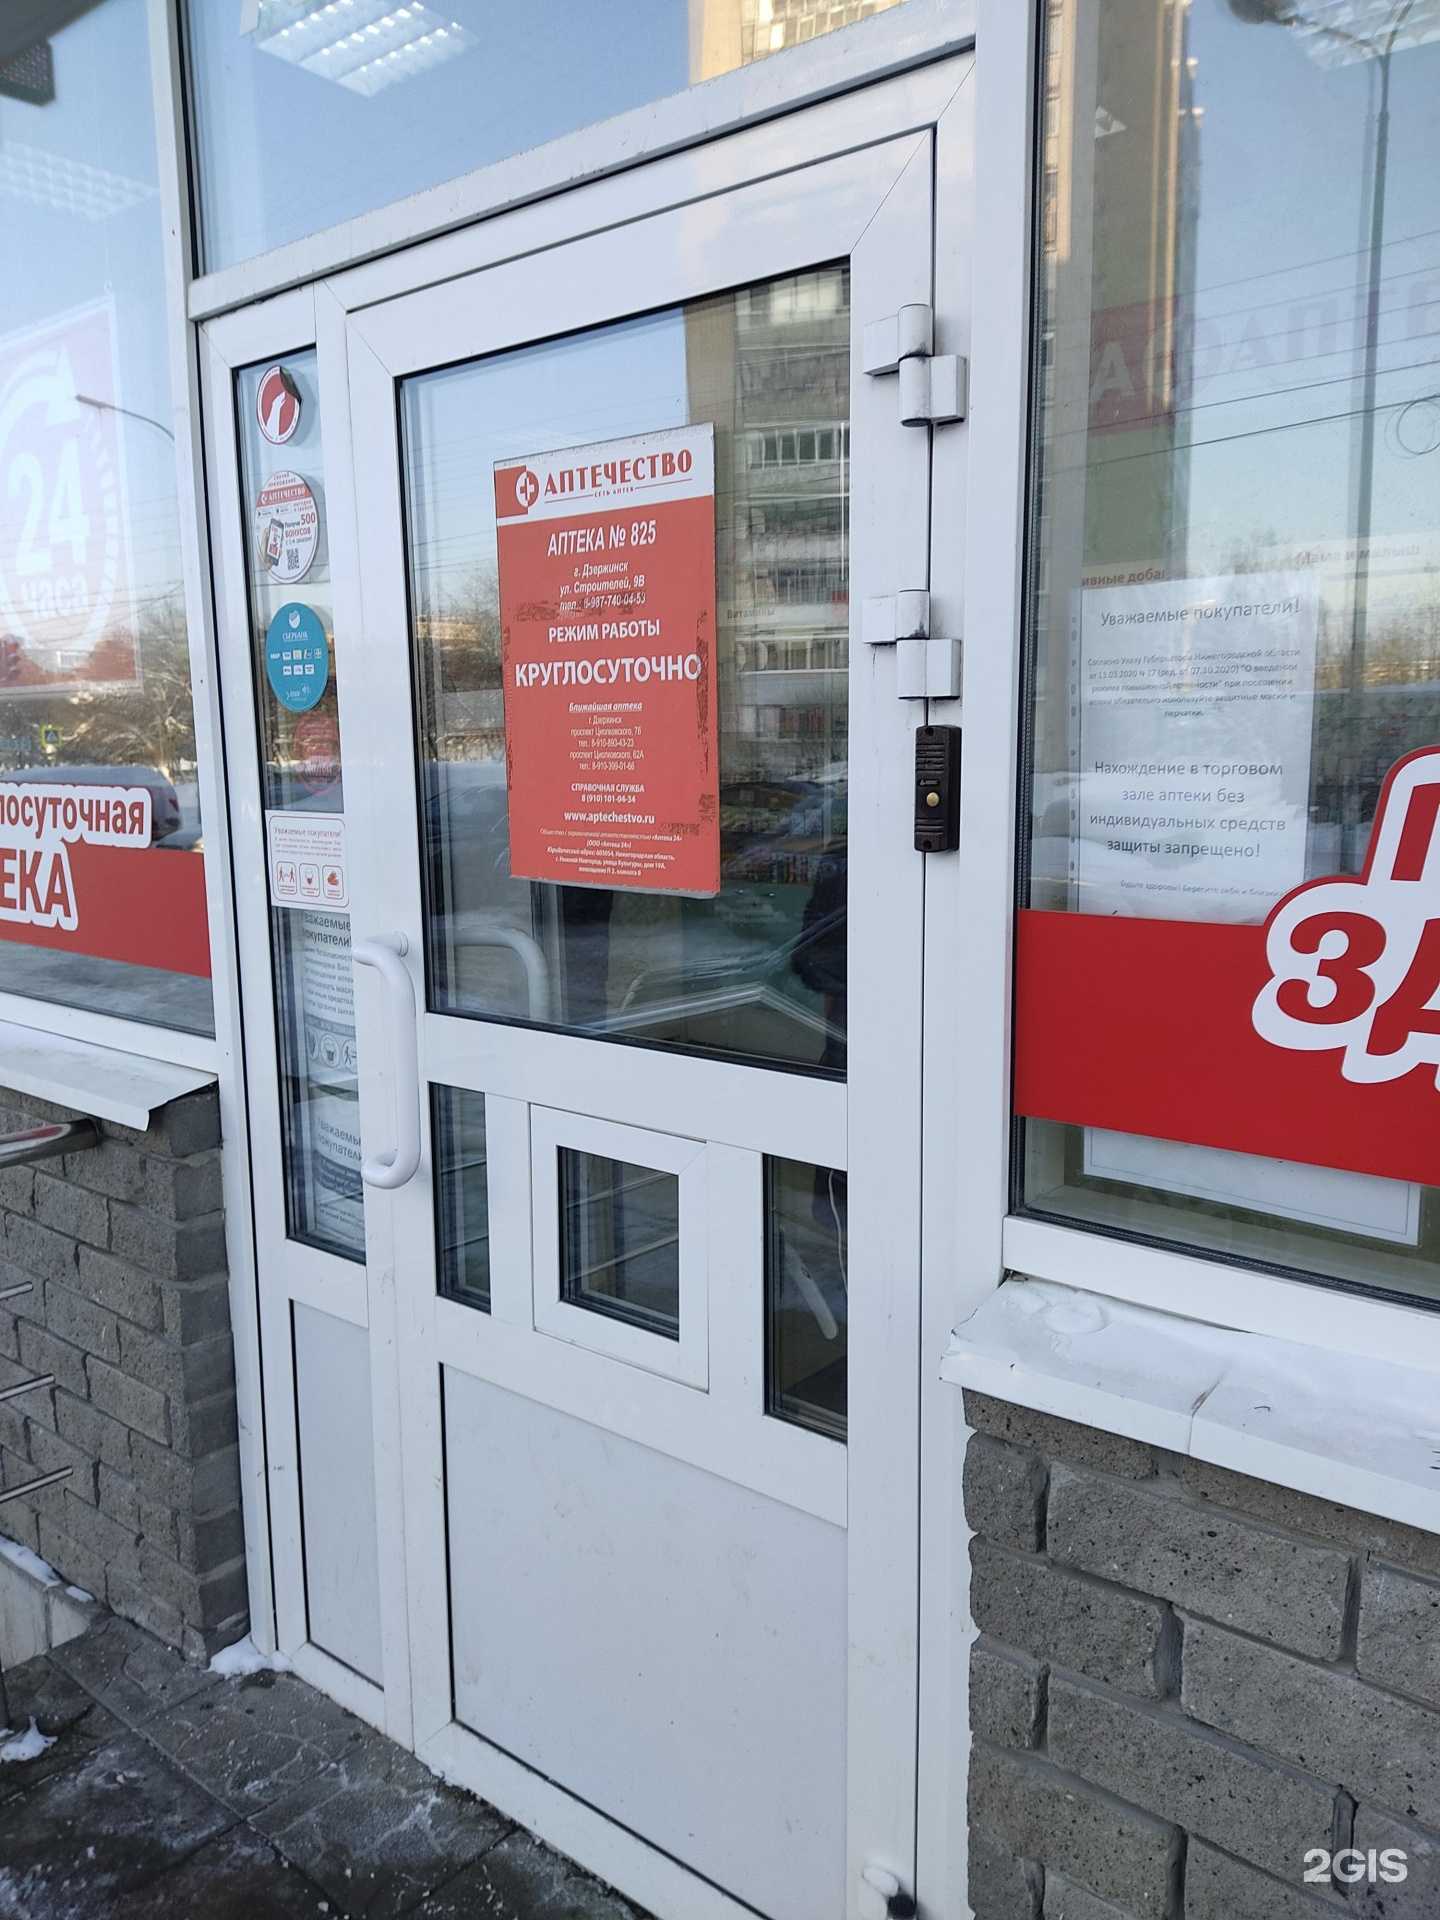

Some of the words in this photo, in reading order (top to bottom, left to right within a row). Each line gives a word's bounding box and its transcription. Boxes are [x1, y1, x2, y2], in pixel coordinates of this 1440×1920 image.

[544, 449, 693, 497] АПТЕЧЕСТВО
[301, 512, 316, 525] 500
[547, 527, 605, 557] АПТЕКА
[609, 524, 627, 547] №
[630, 520, 657, 546] 825
[582, 561, 629, 579] Дзержинск
[560, 584, 572, 598] ул.
[573, 577, 632, 594] Строителей,
[1100, 610, 1190, 626] Уважаемые
[1194, 597, 1302, 620] покупатели!
[548, 623, 599, 643] РЕЖИМ
[602, 619, 661, 640] РАБОТЫ
[515, 653, 702, 688] КРУГЛОСУТОЧНО
[1094, 761, 1186, 777] Нахождение
[1189, 763, 1200, 775] в
[1203, 763, 1283, 780] торговом
[571, 783, 615, 793] СПРАВОЧНАЯ
[616, 783, 645, 793] СЛУЖБА
[1122, 790, 1154, 802] зале
[1158, 790, 1212, 803] аптеки
[1216, 787, 1246, 804] без
[0, 795, 145, 840] осуточная
[564, 810, 656, 825] www.aptechestvo.ru
[1089, 813, 1216, 831] индивидуальных
[1219, 817, 1287, 833] средств
[1107, 839, 1162, 855] защиты
[1165, 841, 1261, 859] запрещено!
